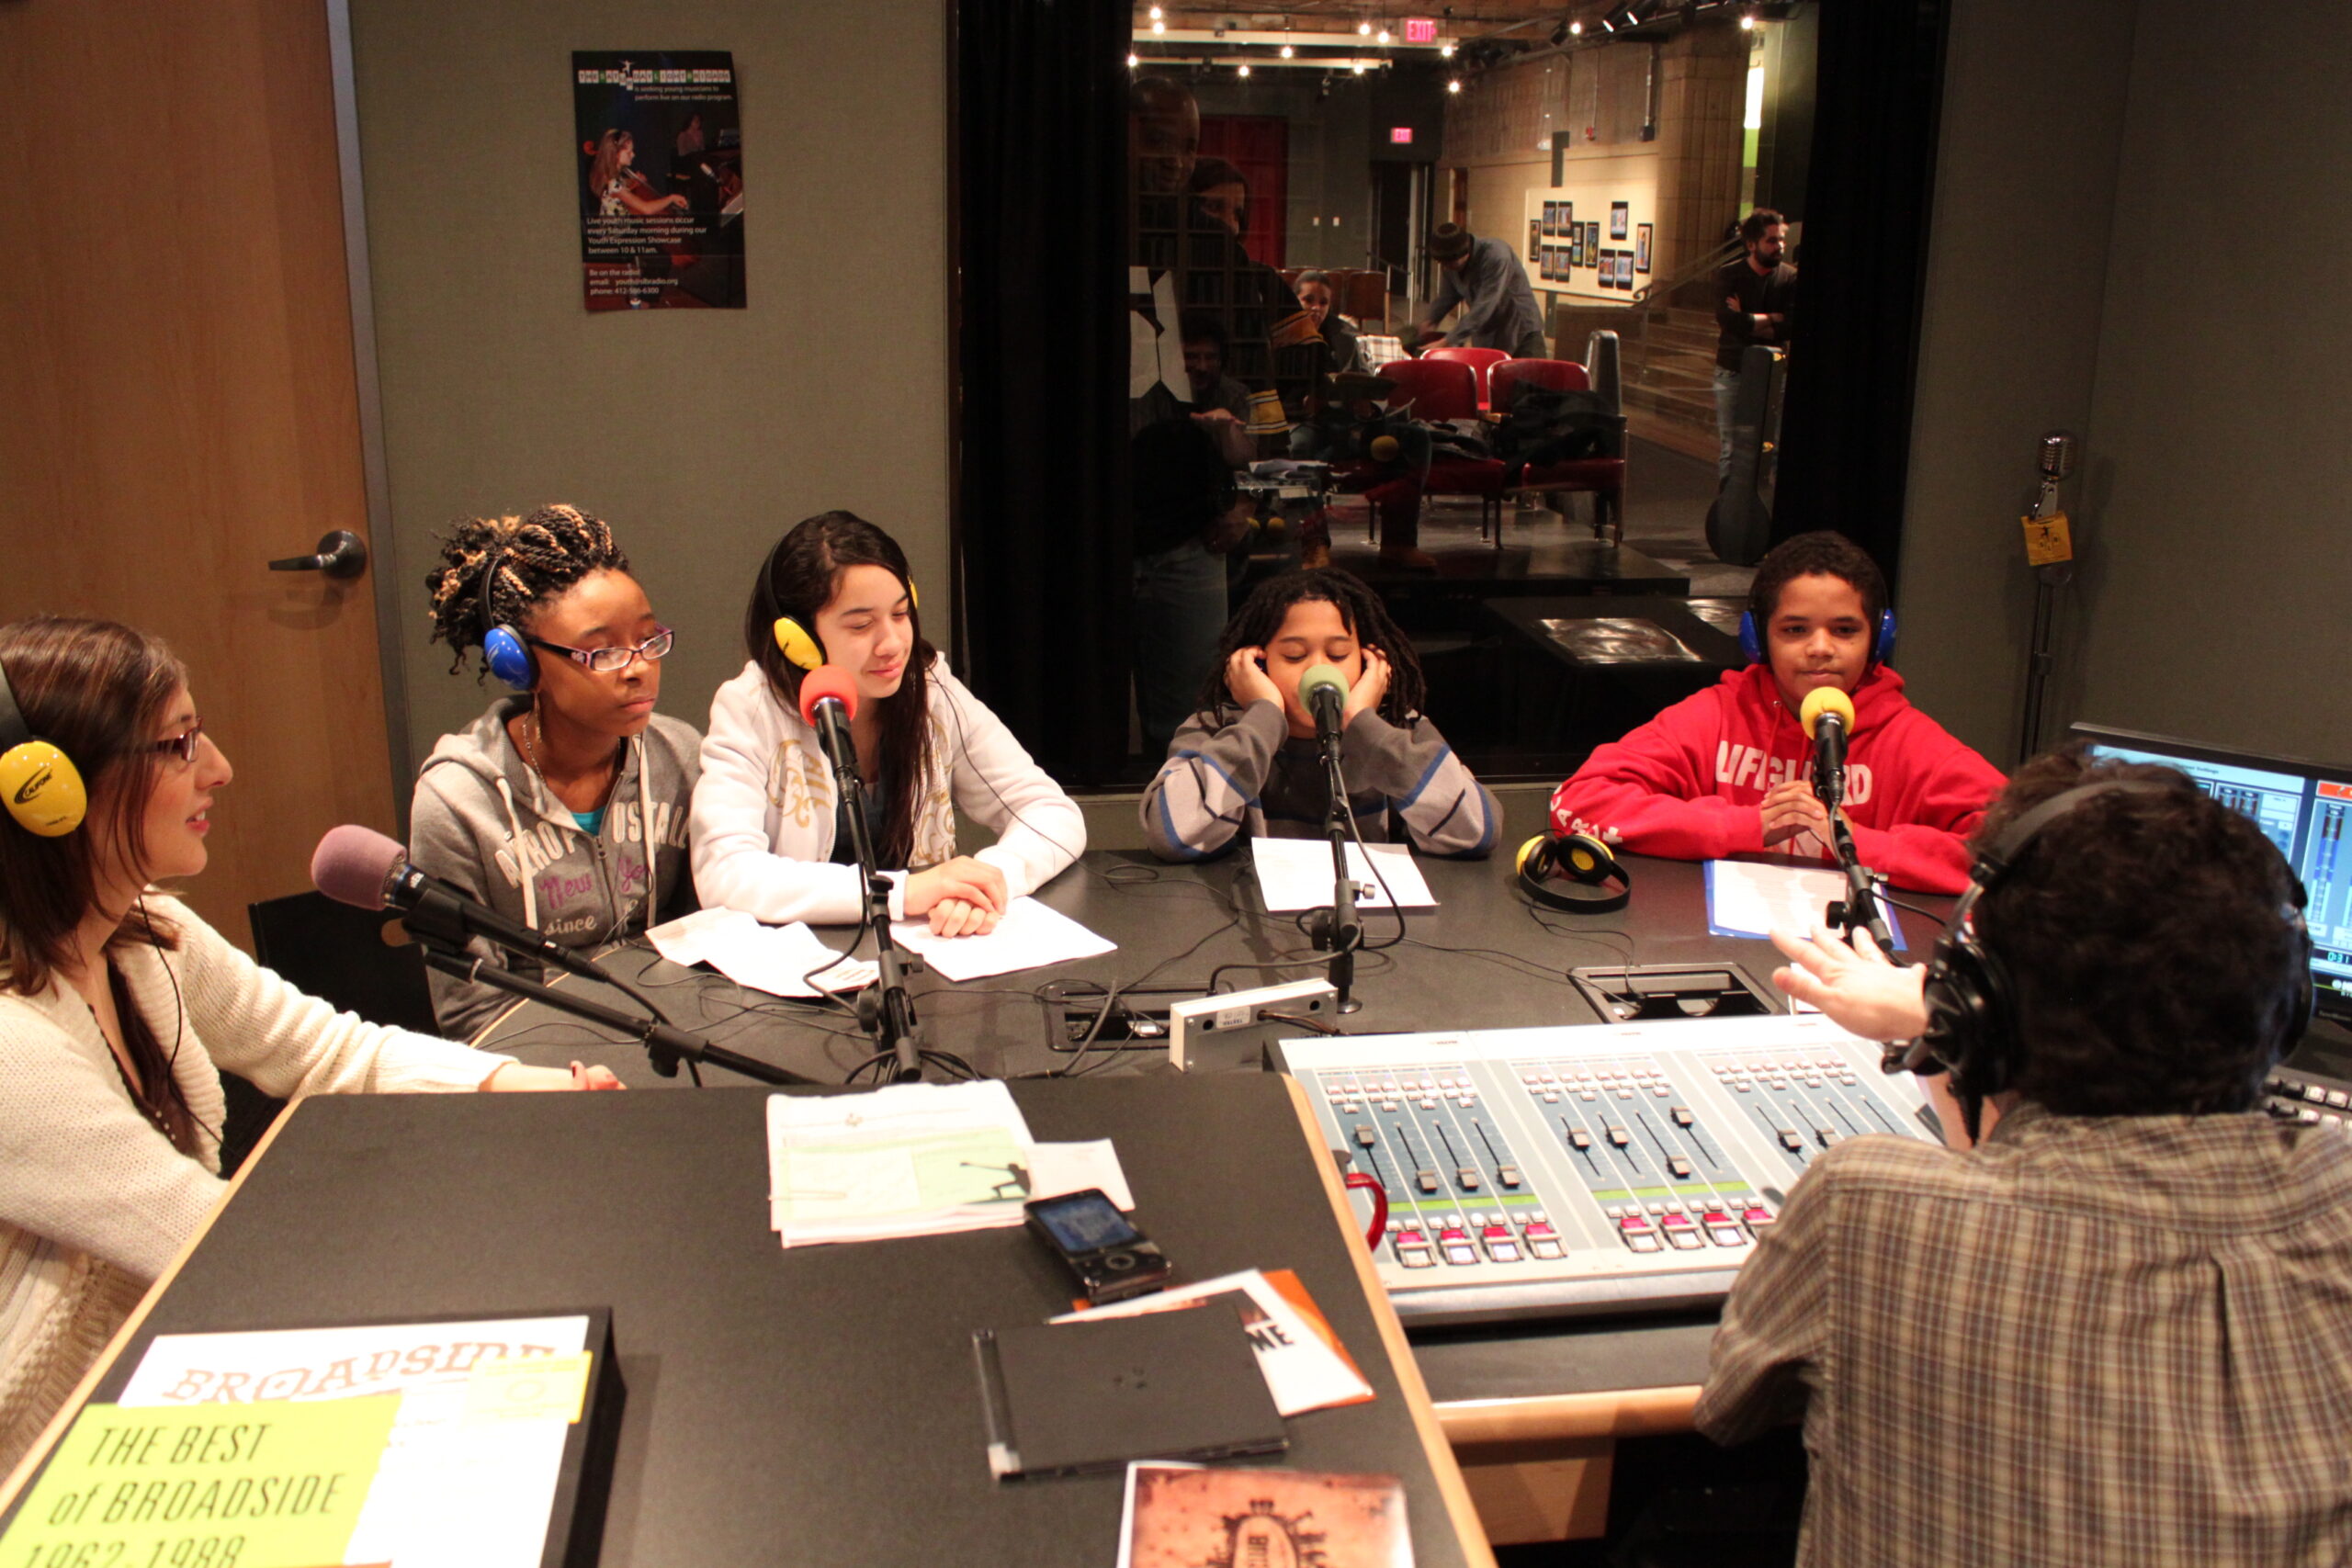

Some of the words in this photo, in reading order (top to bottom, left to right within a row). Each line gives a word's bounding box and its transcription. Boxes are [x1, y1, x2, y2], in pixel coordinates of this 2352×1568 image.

[1407, 19, 1433, 42] EXIT
[578, 70, 599, 84] THE
[1394, 129, 1411, 142] EXIT
[603, 218, 623, 226] youth
[607, 227, 639, 235] Saturday
[670, 227, 694, 235] during
[610, 237, 646, 245] Expression
[590, 288, 613, 296] phone:
[539, 873, 592, 909] New
[545, 915, 597, 936] since
[87, 1426, 168, 1467] THE
[168, 1423, 272, 1465] BEST
[48, 1481, 103, 1526] of
[101, 1472, 345, 1524] BROADSIDE
